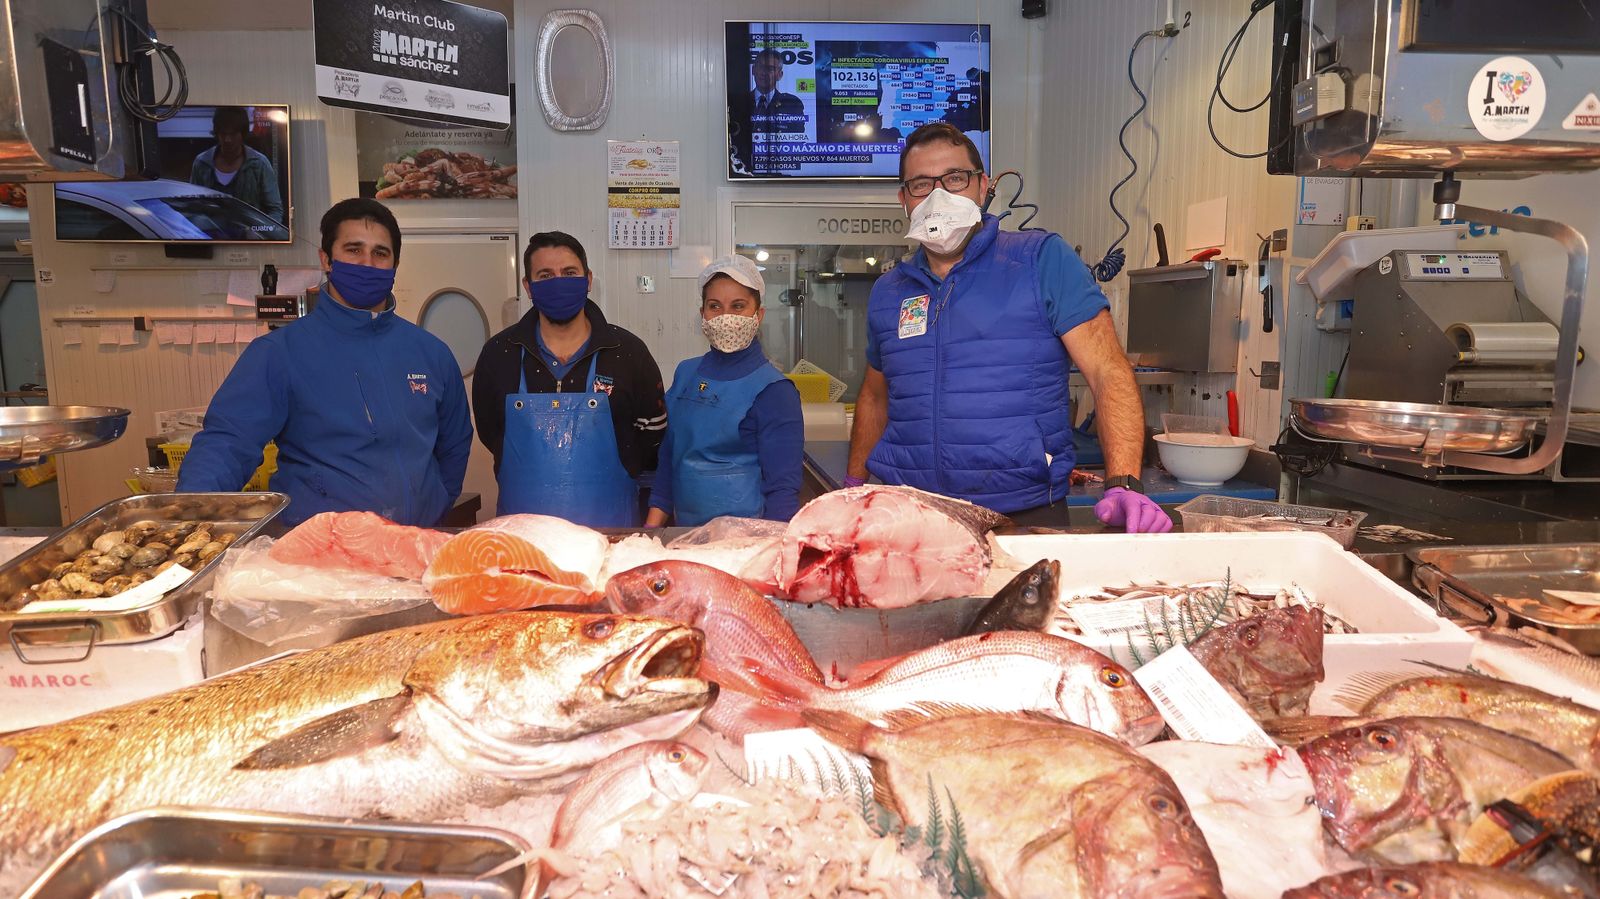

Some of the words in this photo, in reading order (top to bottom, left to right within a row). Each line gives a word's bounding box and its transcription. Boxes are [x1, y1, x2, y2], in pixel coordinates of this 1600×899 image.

[374, 4, 420, 24] Martin
[423, 15, 455, 31] Club
[1183, 12, 1191, 27] 2
[833, 72, 876, 81] 102.136
[1483, 71, 1498, 104] I
[405, 130, 446, 138] Adelántate
[61, 147, 86, 159] EPELSA
[754, 144, 790, 152] NUEVO
[792, 142, 835, 152] MÁXIMO
[853, 144, 901, 152] MUERTES:
[817, 218, 903, 234] COCEDERO
[9, 675, 94, 689] MAROC
